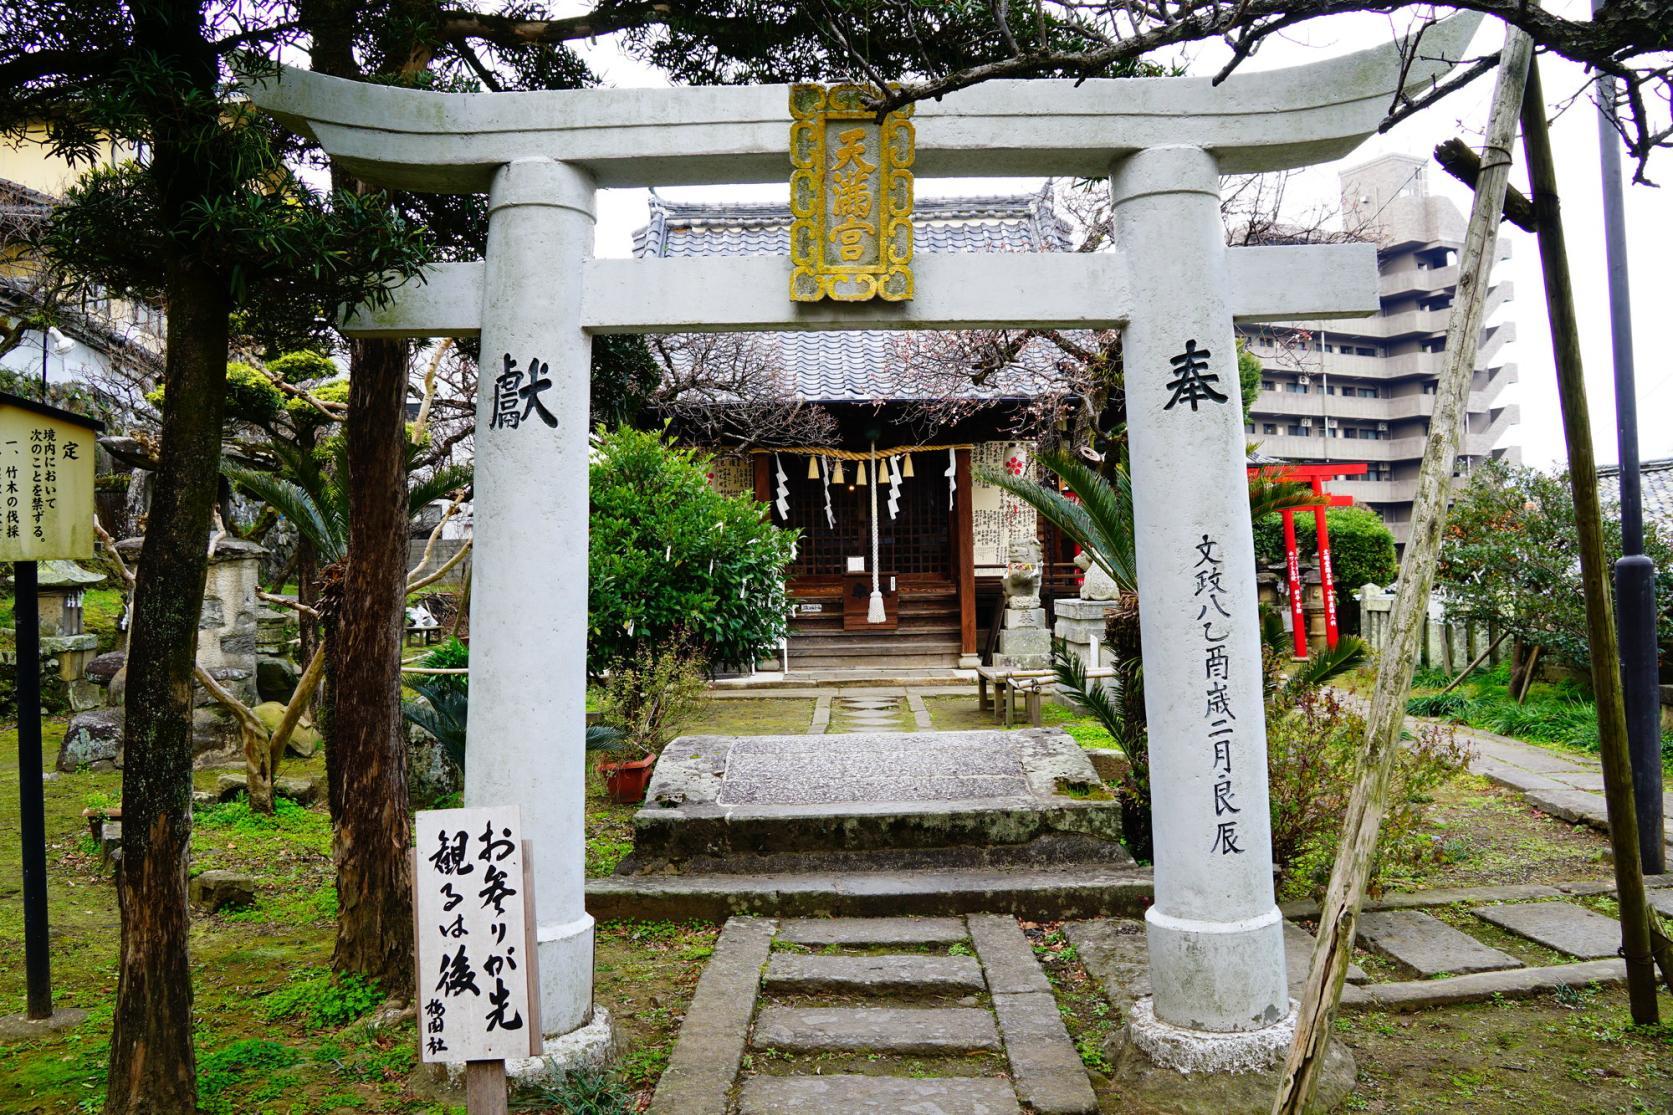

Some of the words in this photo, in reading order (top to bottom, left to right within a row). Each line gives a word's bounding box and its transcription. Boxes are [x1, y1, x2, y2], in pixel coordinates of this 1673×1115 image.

[1163, 339, 1228, 412] 奉
[30, 428, 45, 542] 次のことを禁ずる。
[44, 429, 56, 508] 境内において
[62, 441, 79, 460] 定
[428, 830, 481, 998] 観るは後
[477, 820, 523, 1033] お参りが先
